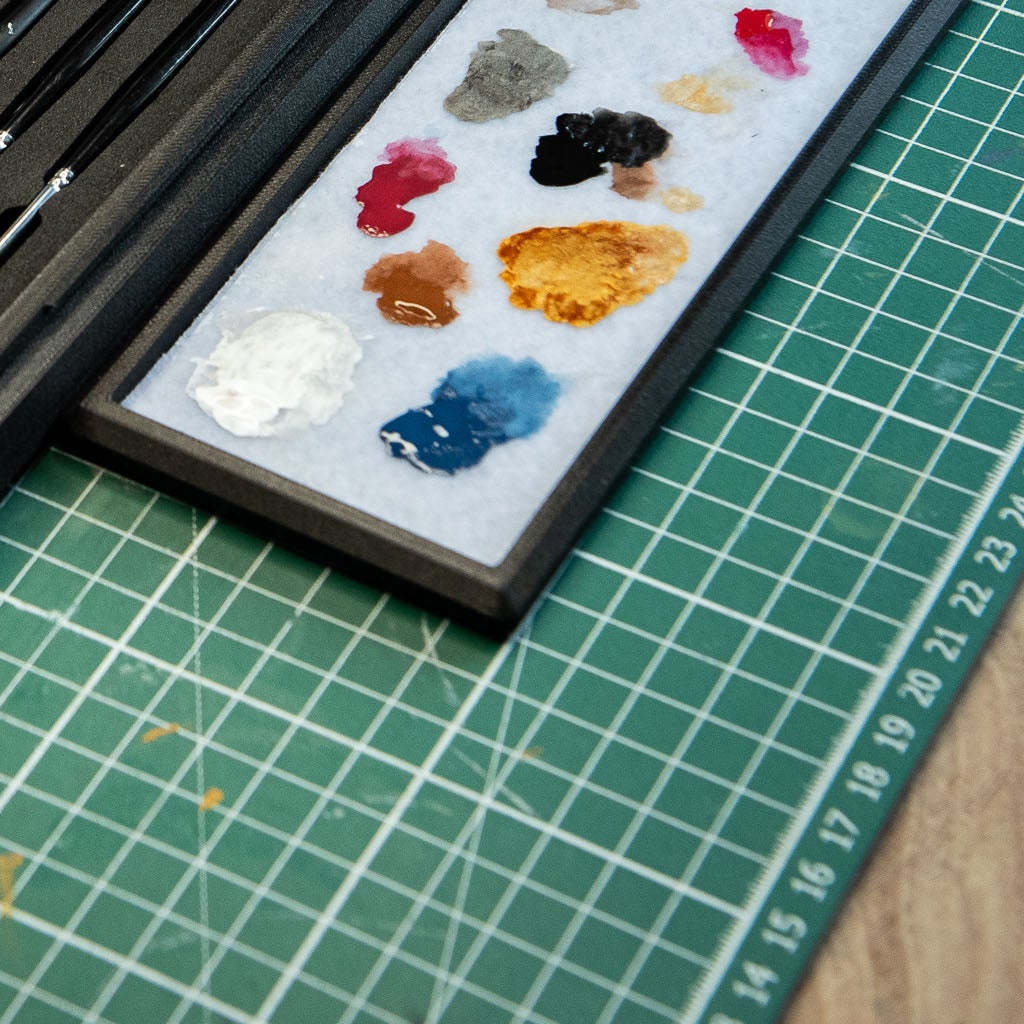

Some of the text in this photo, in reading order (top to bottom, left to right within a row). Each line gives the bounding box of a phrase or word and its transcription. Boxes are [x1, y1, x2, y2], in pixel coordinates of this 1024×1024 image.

[732, 960, 780, 1006] 14
[762, 907, 807, 953] 15
[791, 858, 835, 902] 16
[818, 808, 860, 851] 17
[845, 760, 890, 802] 18
[872, 714, 915, 754] 19
[896, 668, 942, 708] 20
[922, 626, 968, 662] 21
[948, 579, 994, 617] 22
[974, 535, 1017, 573] 23
